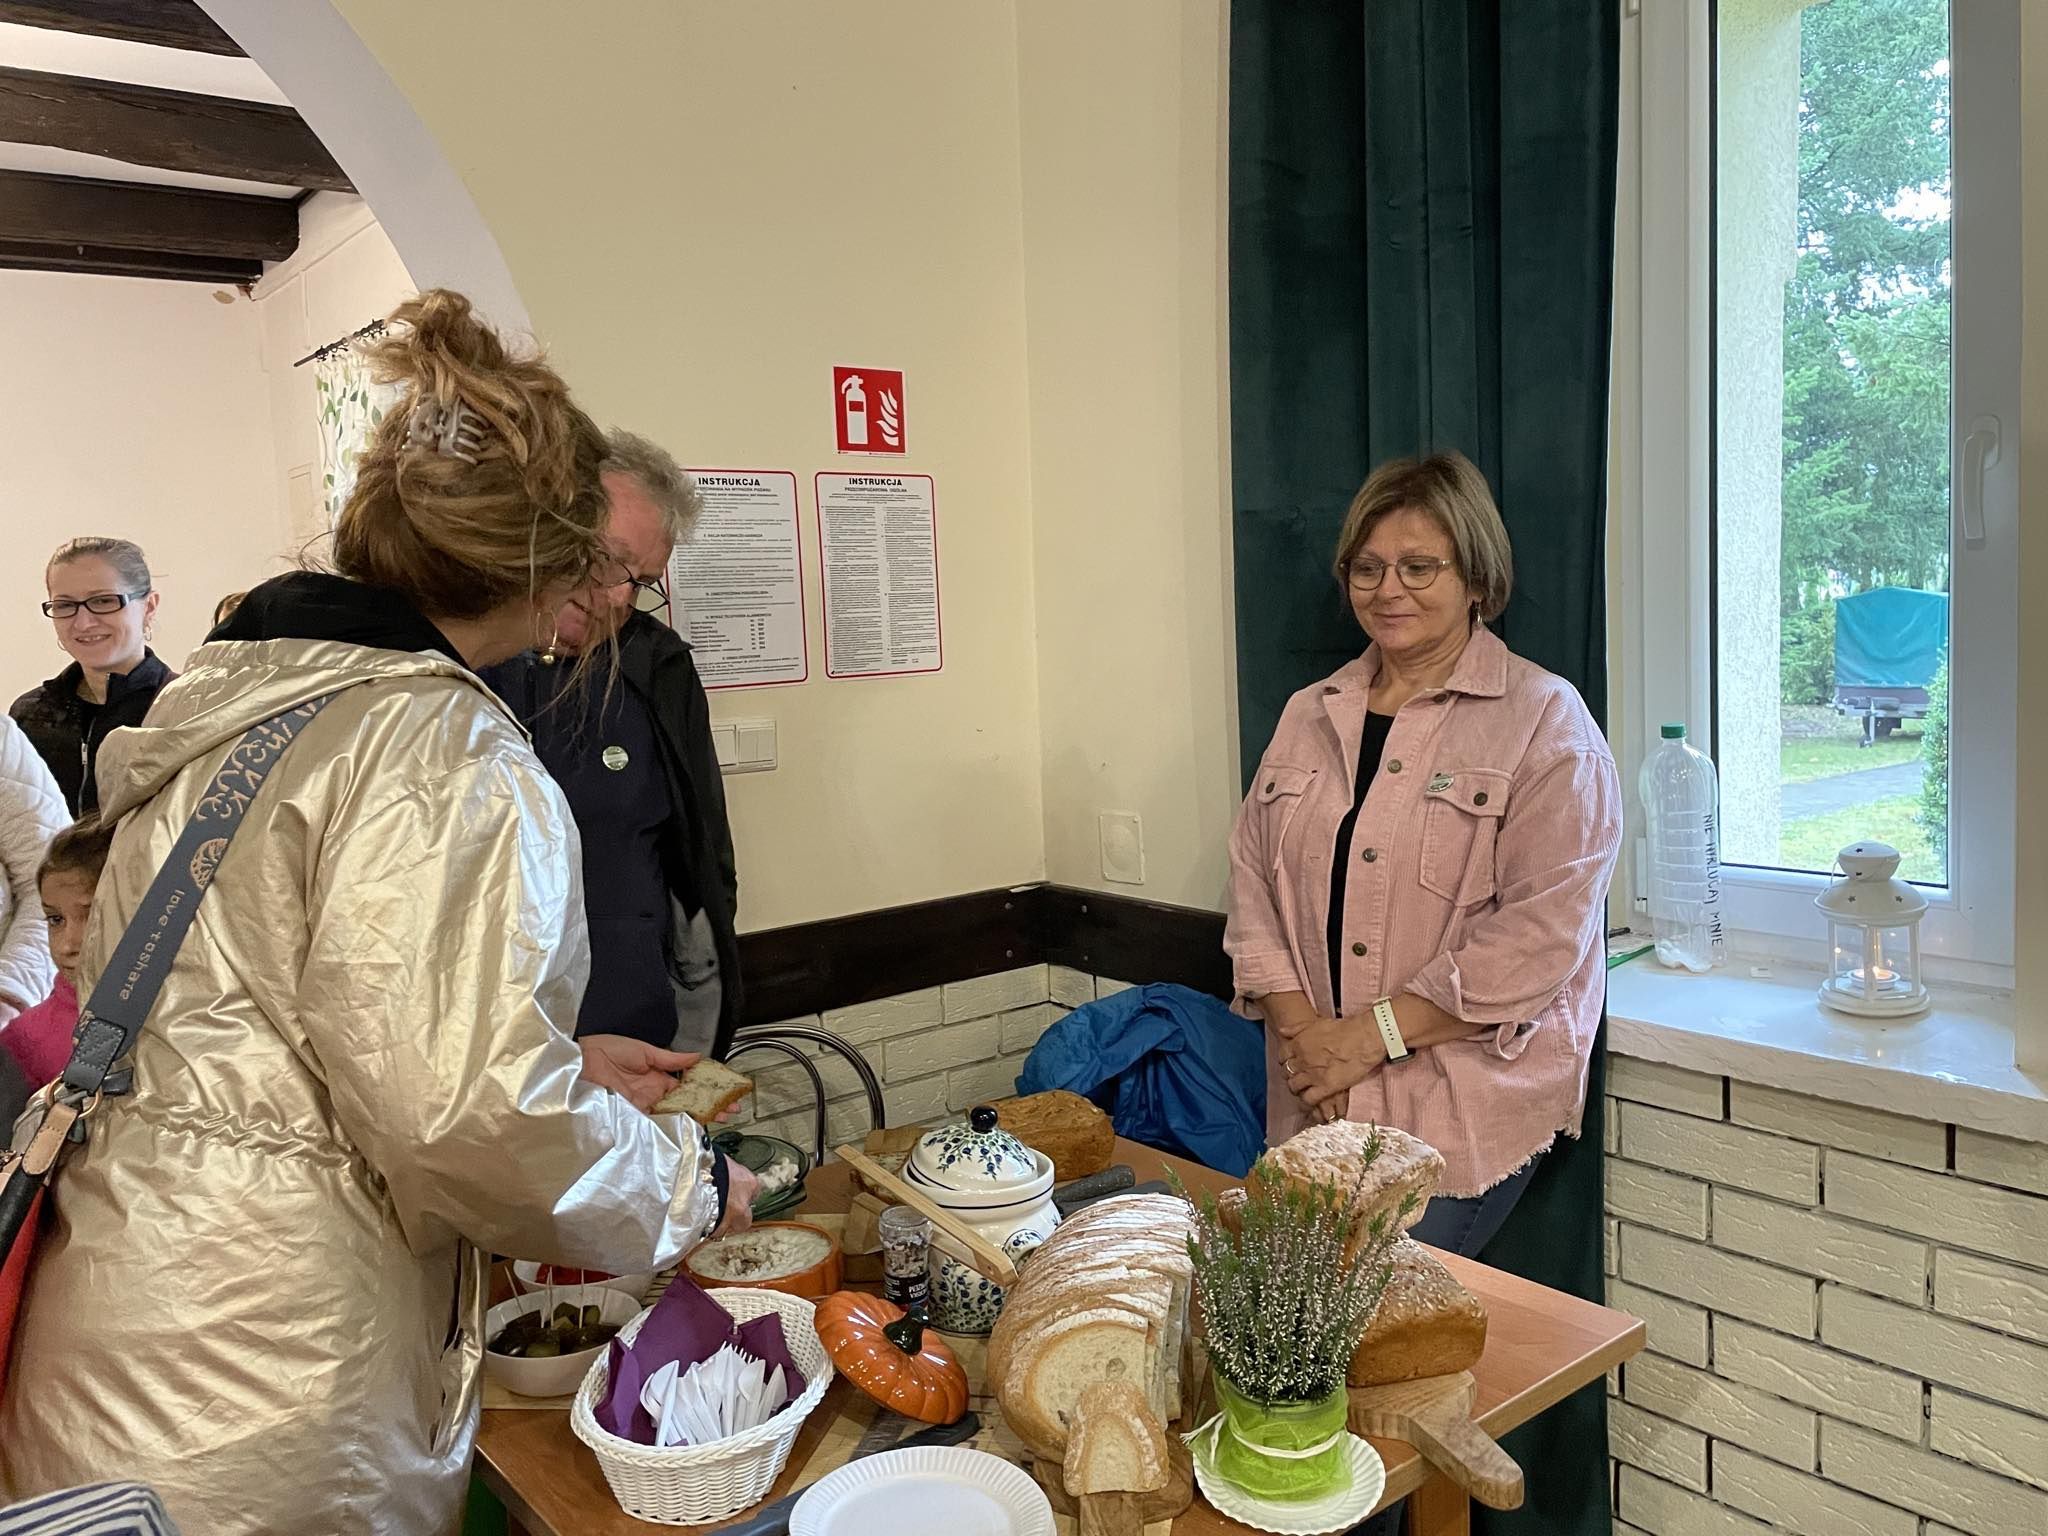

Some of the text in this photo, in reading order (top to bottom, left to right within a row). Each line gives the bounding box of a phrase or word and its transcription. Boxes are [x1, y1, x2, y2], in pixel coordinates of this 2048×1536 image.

[698, 477, 761, 486] INSTRUKCJA
[849, 478, 903, 486] INSTRUKCJA
[1702, 814, 1715, 835] NIE
[1710, 911, 1723, 947] MNIE
[158, 889, 185, 927] love
